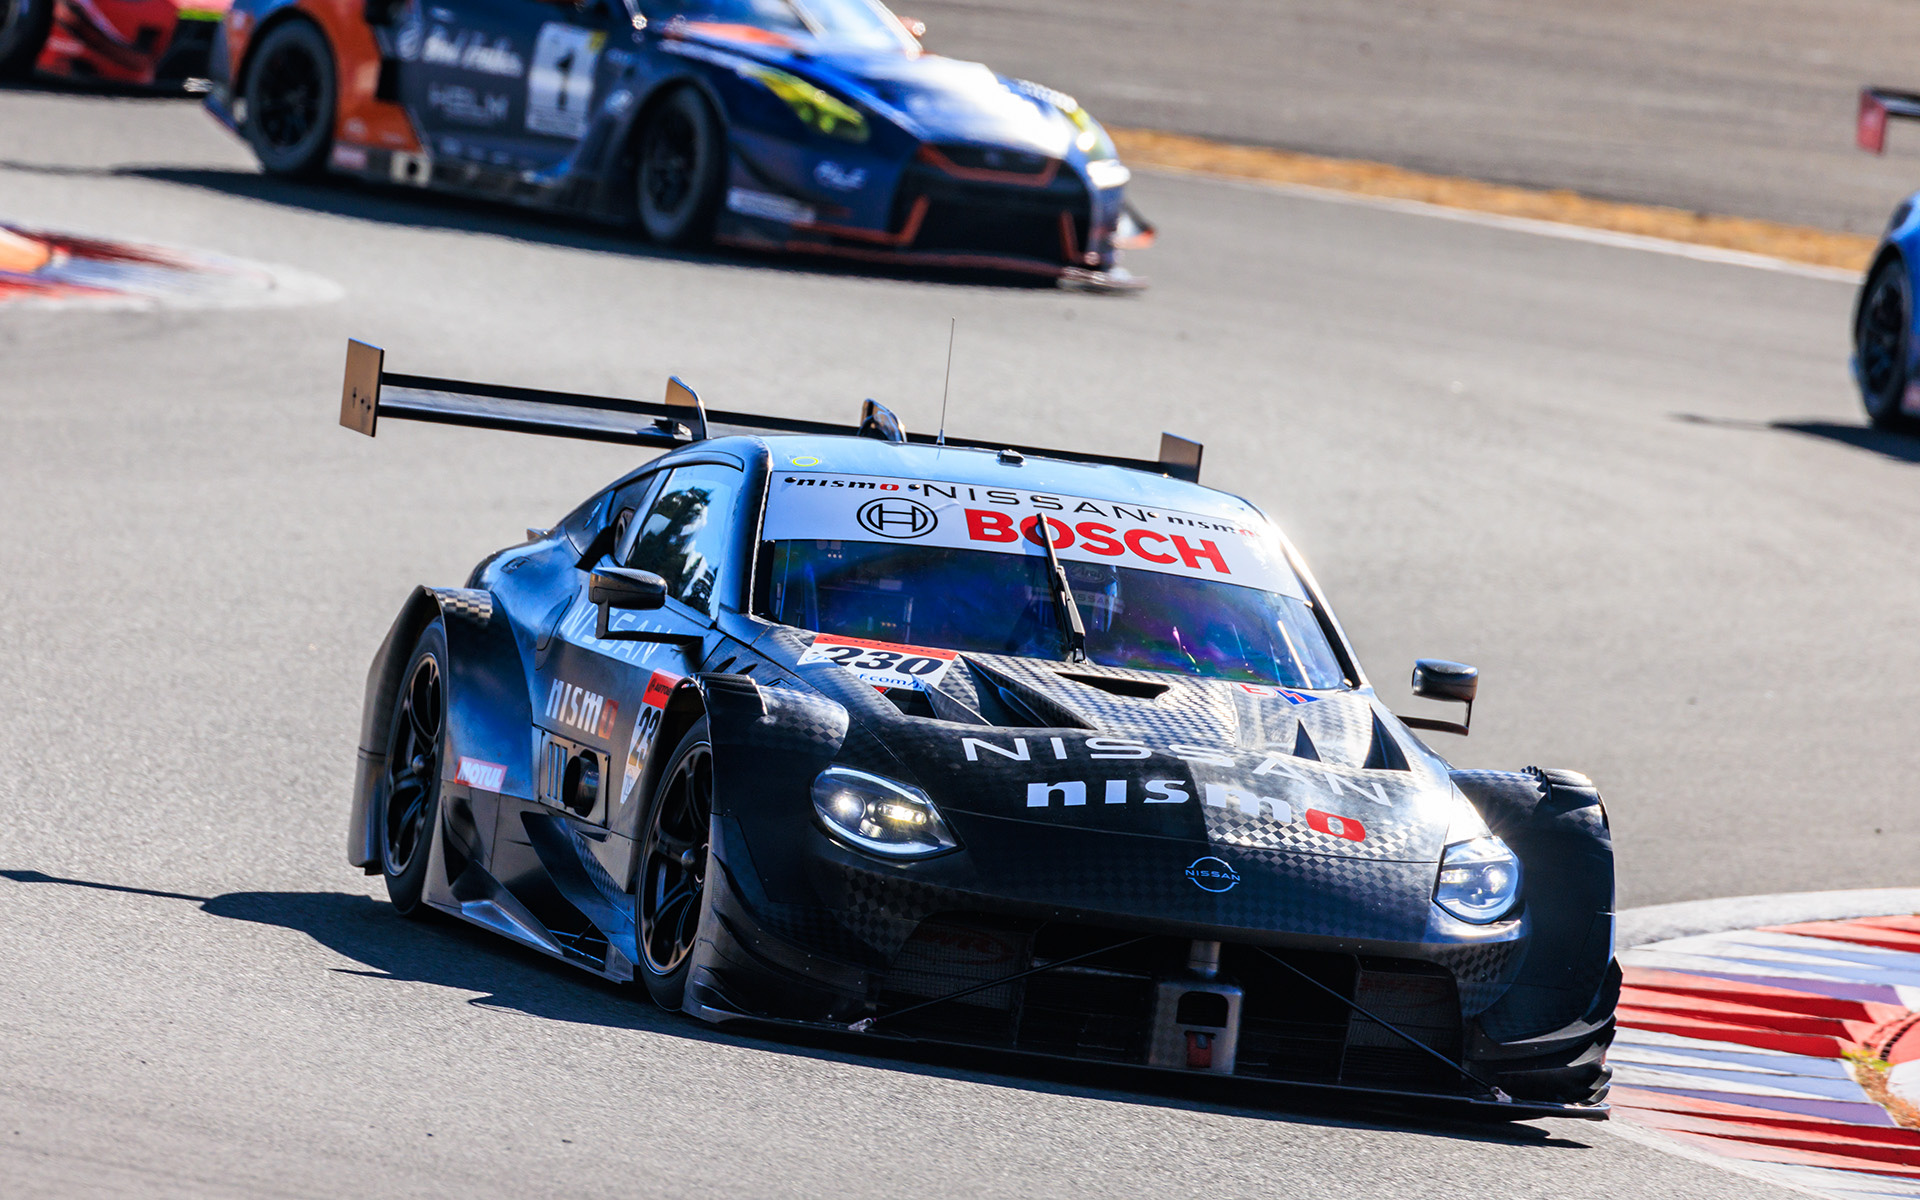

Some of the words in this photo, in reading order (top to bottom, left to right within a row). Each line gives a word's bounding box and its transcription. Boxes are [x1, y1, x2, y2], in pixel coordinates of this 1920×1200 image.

[797, 478, 899, 491] nismo
[923, 484, 1157, 523] NISSAN
[964, 508, 1232, 575] BOSCH
[824, 646, 944, 676] 230
[545, 678, 620, 740] nismo
[457, 761, 503, 788] MOTUL
[963, 737, 1393, 807] NISSAN
[1026, 779, 1367, 842] nismo
[1185, 869, 1241, 882] NISSAN
